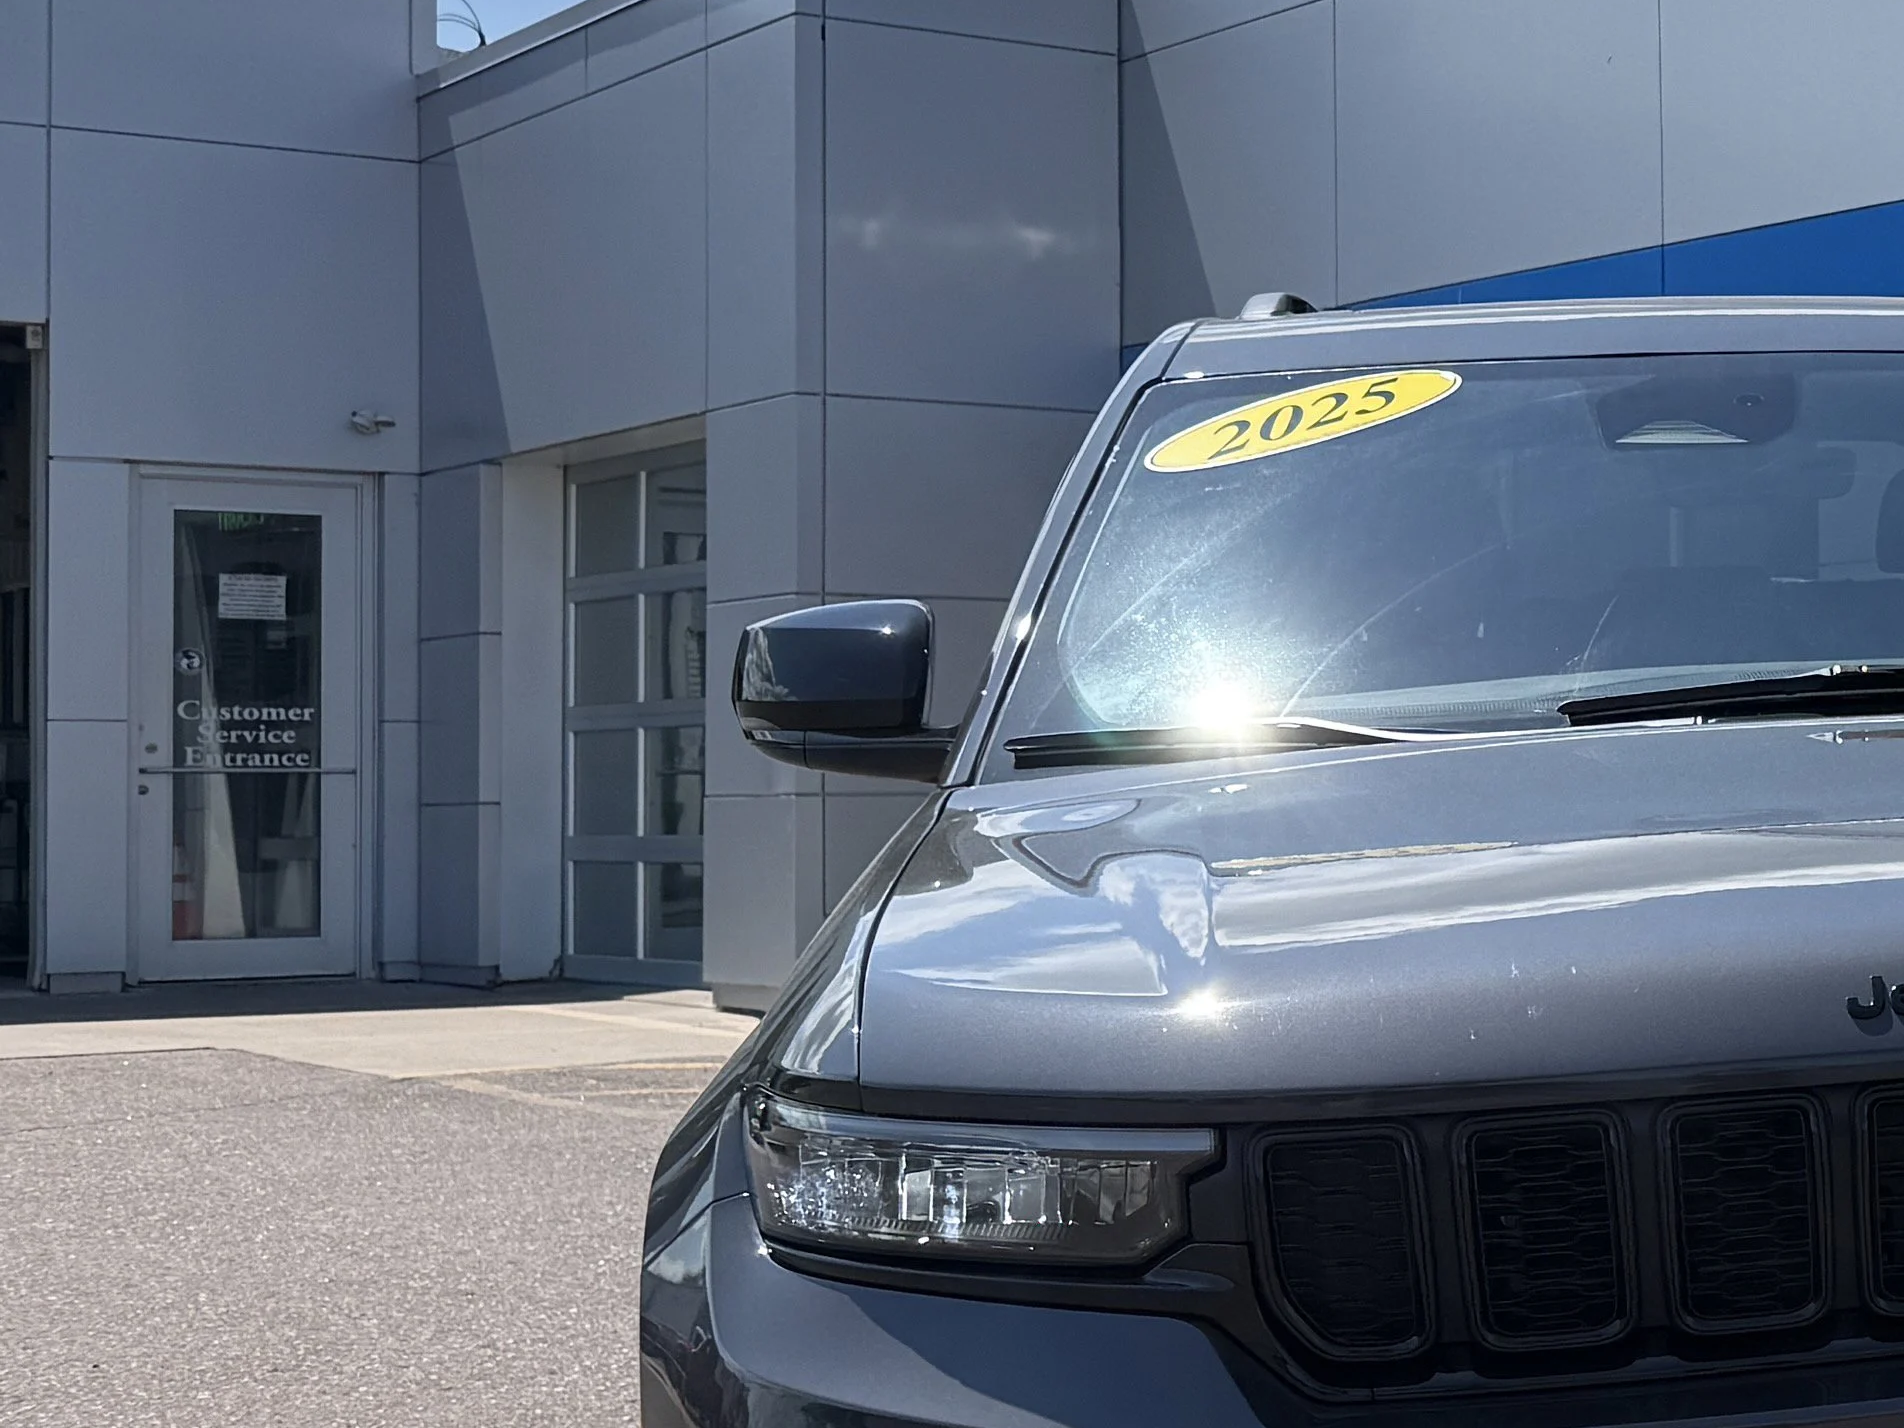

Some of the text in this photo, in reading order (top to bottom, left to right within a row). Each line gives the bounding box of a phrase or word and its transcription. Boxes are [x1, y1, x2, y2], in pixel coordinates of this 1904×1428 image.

[1207, 377, 1399, 460] 2025
[177, 700, 315, 721] Customer
[196, 724, 296, 743] Service
[184, 746, 310, 767] Entrance
